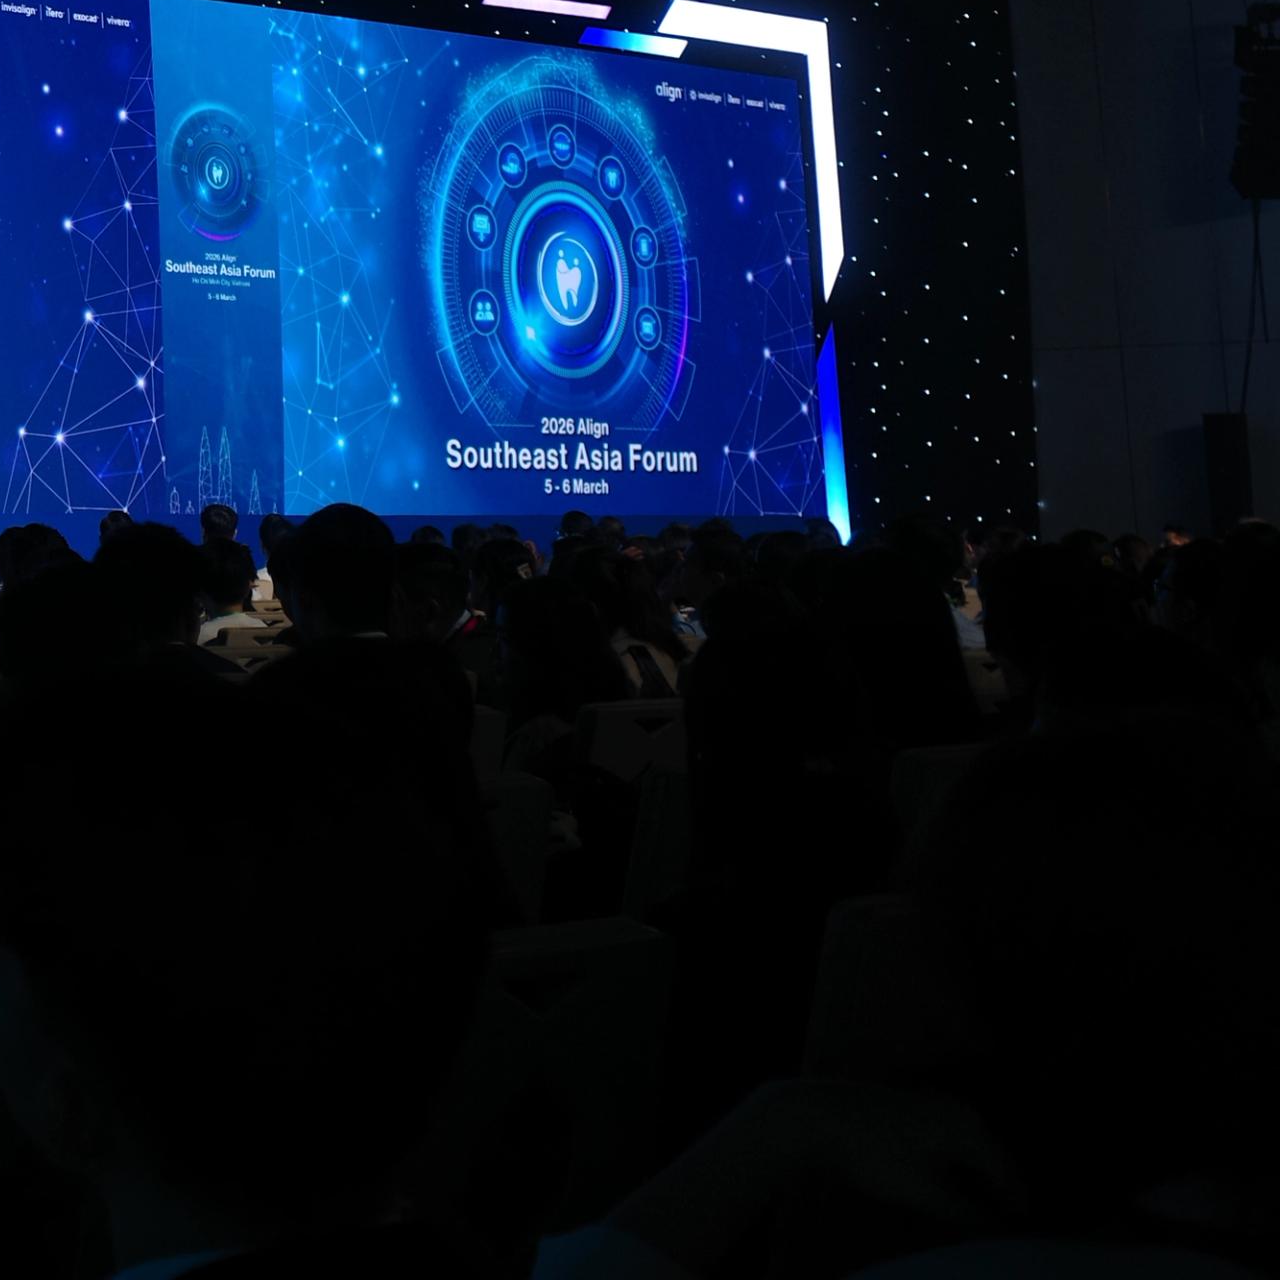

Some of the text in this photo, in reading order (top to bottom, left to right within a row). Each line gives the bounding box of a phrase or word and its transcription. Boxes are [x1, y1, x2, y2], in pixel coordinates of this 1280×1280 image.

[1, 1, 36, 17] invisalign
[656, 82, 682, 102] align
[165, 260, 275, 279] Southeast Asia Forum
[541, 417, 609, 439] 2026 Align
[446, 438, 697, 472] Southeast Asia Forum
[544, 478, 552, 494] 5
[562, 479, 570, 494] 6
[573, 479, 609, 494] March
